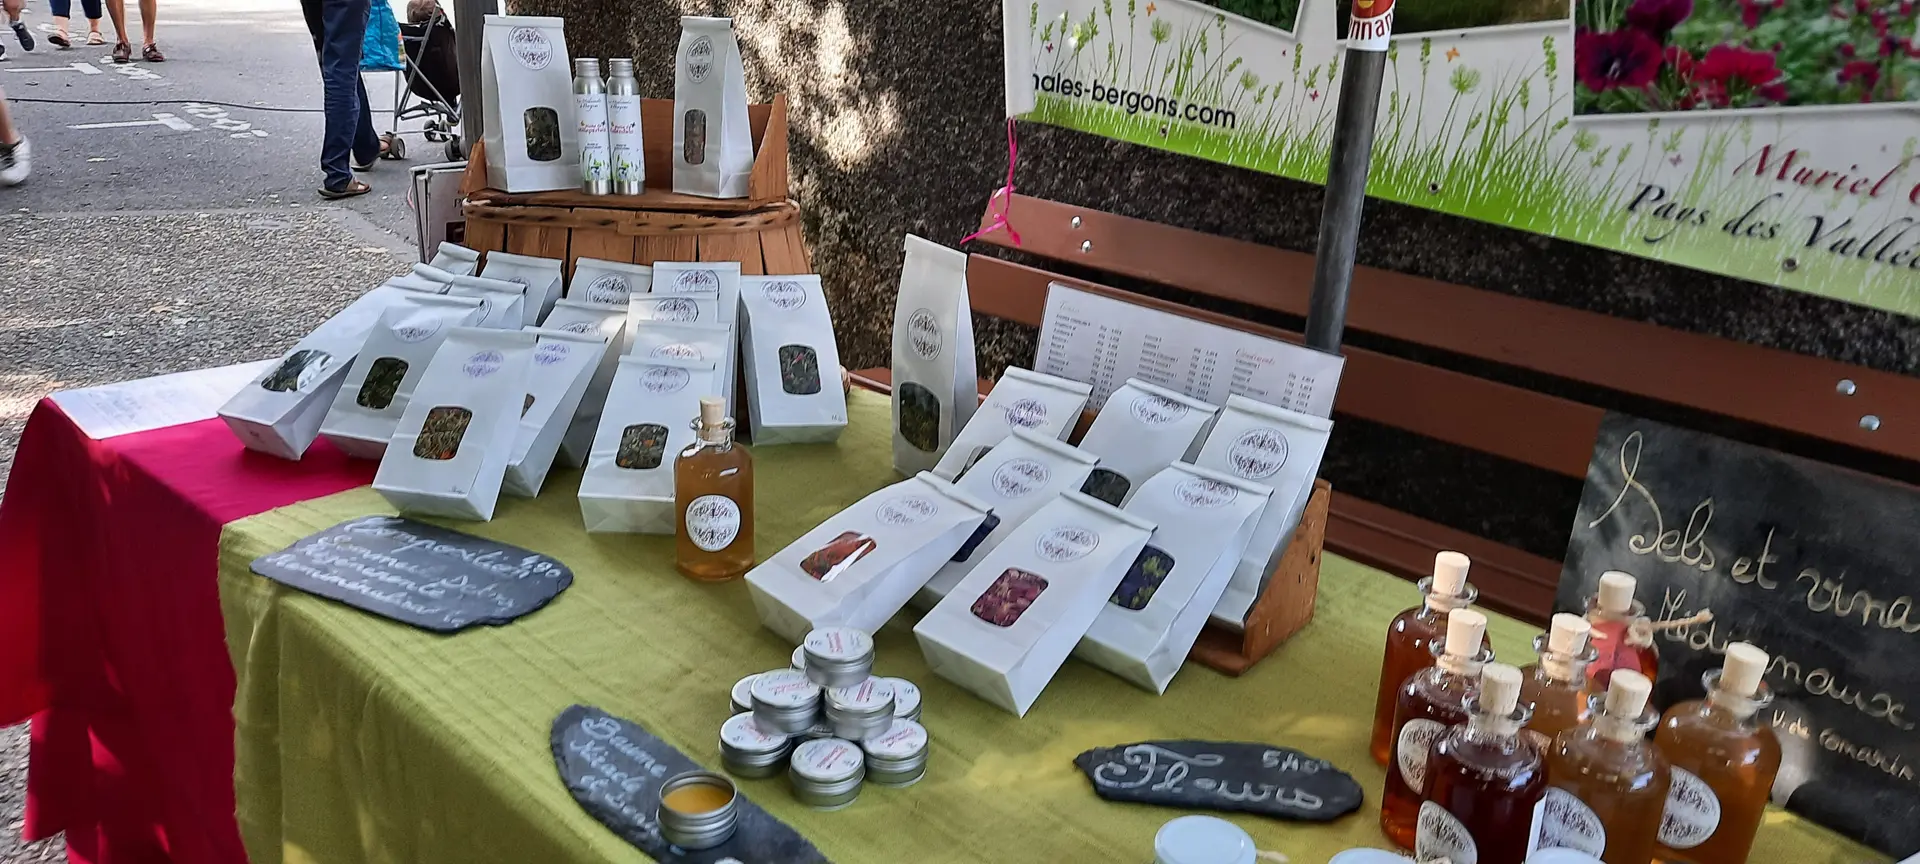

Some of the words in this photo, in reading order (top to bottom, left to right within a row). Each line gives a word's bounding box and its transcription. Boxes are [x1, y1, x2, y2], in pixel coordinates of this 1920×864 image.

[1732, 143, 1919, 197] Muriel
[1627, 183, 1710, 244] Pays
[1722, 192, 1784, 240] des
[1588, 430, 1716, 572] Sels
[1731, 525, 1778, 590] et
